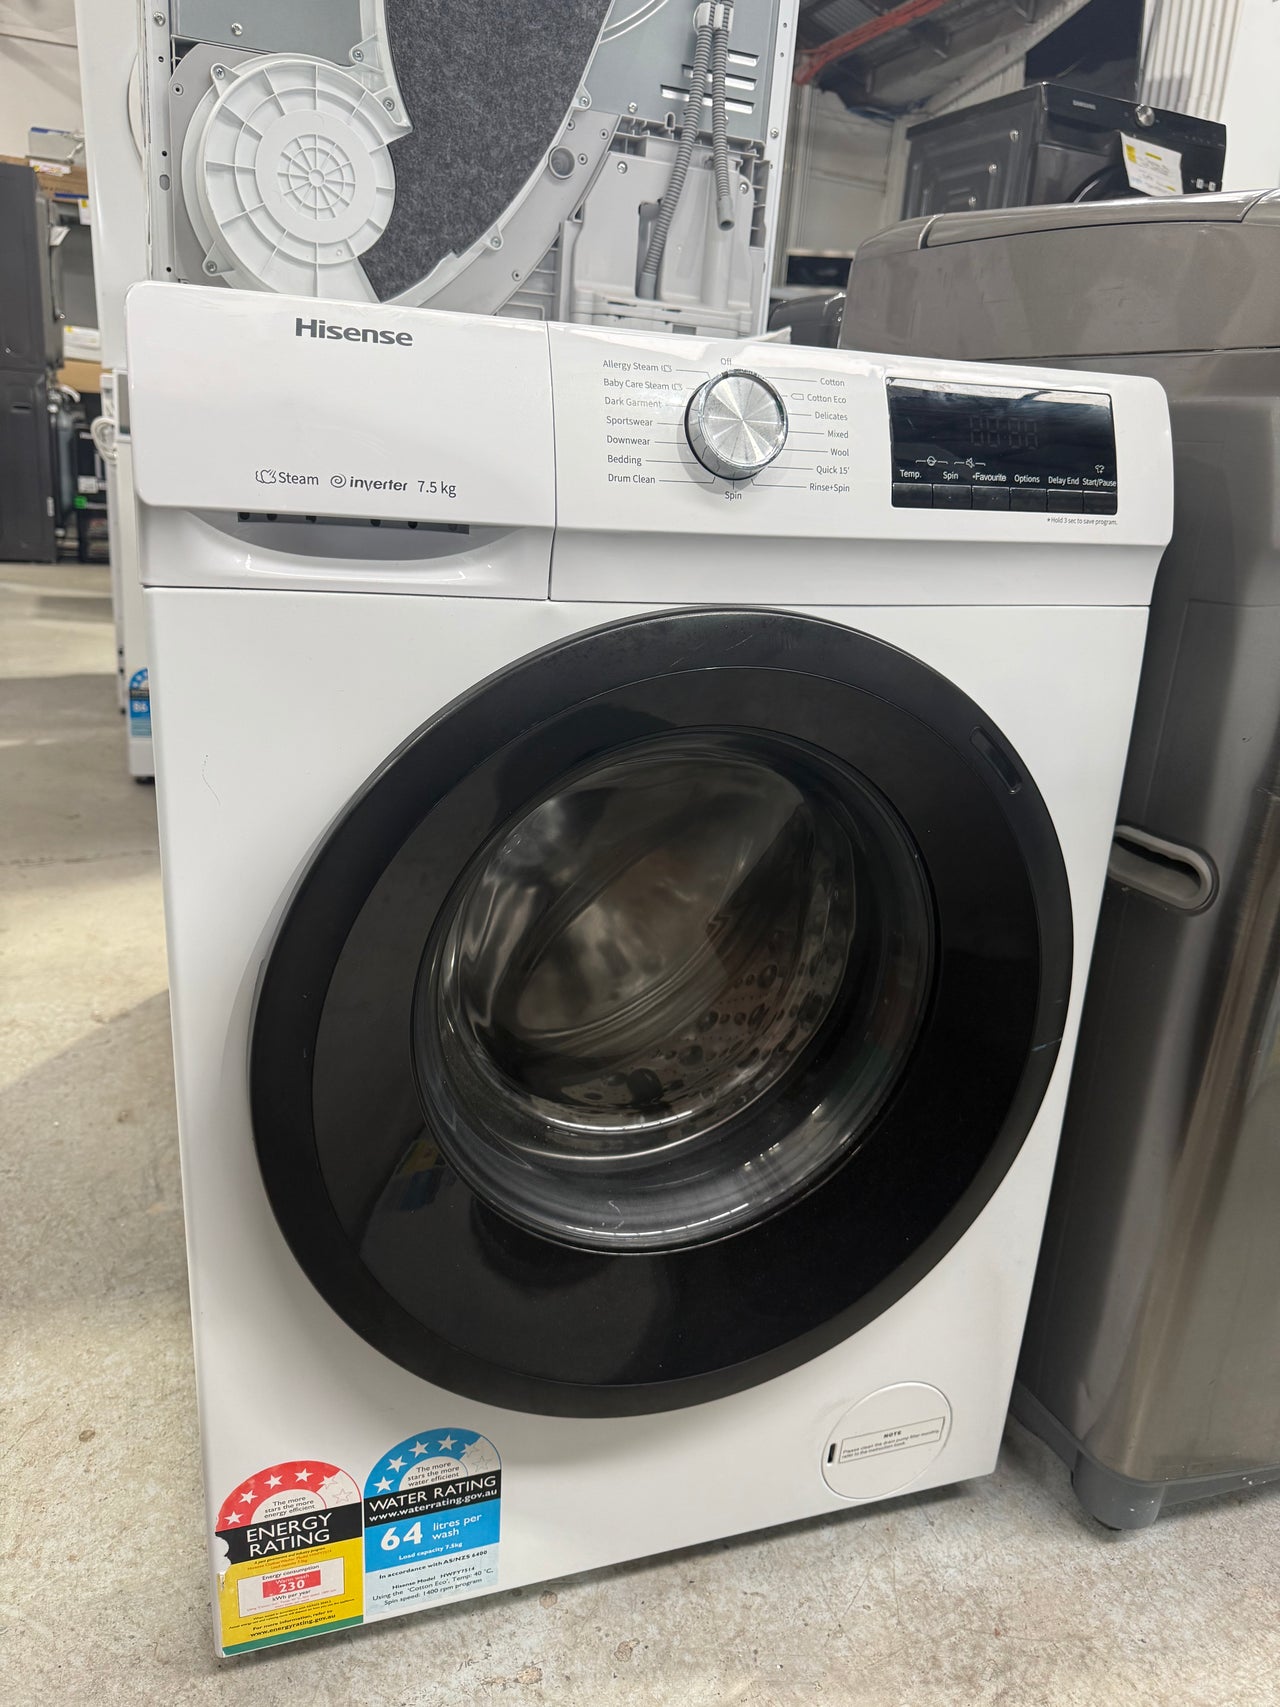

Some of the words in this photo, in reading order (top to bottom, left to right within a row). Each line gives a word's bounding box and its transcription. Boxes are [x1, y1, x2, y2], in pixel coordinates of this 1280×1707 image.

[295, 317, 413, 347] Hisense
[602, 359, 631, 371] Allergy
[634, 362, 659, 372] Steam
[720, 357, 732, 366] Off
[603, 378, 624, 390] Baby
[625, 380, 645, 389] Care
[645, 381, 670, 391] Steam
[820, 377, 845, 387] Cotton
[604, 396, 624, 406] Dark
[626, 398, 663, 408] Garment
[807, 393, 832, 403] Cotton
[834, 395, 847, 404] Eco
[606, 416, 653, 427] Sportswear
[814, 411, 848, 421] Delicates
[606, 435, 650, 446] Downwear
[827, 429, 849, 439] Mixed
[830, 447, 850, 457] Wool
[607, 454, 642, 467] Bedding
[816, 465, 838, 476] Quick
[900, 469, 922, 480] Temp.
[943, 471, 959, 481] Spin
[278, 471, 319, 486] Steam
[350, 476, 408, 492] inverter
[608, 473, 631, 483] Drum
[633, 474, 656, 484] Clean
[1014, 474, 1040, 484] Options
[1048, 476, 1066, 486] Delay
[1067, 477, 1080, 486] End
[1082, 478, 1117, 488] Start/Pause
[417, 480, 438, 494] 7.5
[441, 481, 457, 498] kg
[809, 482, 851, 493] Rinse+Spin
[724, 490, 742, 502] Spin
[883, 1430, 902, 1439] NOTE
[407, 1473, 426, 1482] stars
[427, 1470, 439, 1478] the
[440, 1465, 460, 1475] more
[416, 1465, 431, 1473] The
[431, 1461, 452, 1471] more
[408, 1478, 429, 1488] water
[431, 1471, 459, 1483] efficient
[369, 1490, 428, 1512] WATER
[434, 1475, 497, 1499] RATING
[264, 1506, 281, 1514] stars
[295, 1499, 314, 1508] more
[272, 1499, 286, 1507] The
[287, 1496, 306, 1504] more
[368, 1488, 498, 1522] www.waterrating.gov.au
[264, 1509, 288, 1519] energy
[289, 1504, 316, 1514] efficient
[246, 1512, 332, 1543] ENERGY
[433, 1519, 460, 1531] litres
[463, 1513, 482, 1526] per
[380, 1521, 423, 1551] 64
[432, 1527, 460, 1541] wash
[249, 1528, 330, 1557] RATING
[398, 1551, 416, 1561] Load
[416, 1545, 444, 1557] capacity
[387, 1564, 426, 1578] accordance
[427, 1561, 443, 1569] with
[443, 1553, 471, 1565] AS/NZS
[471, 1549, 488, 1558] 6400
[262, 1570, 282, 1581] Energy
[283, 1564, 320, 1577] consumption
[278, 1579, 305, 1594] 230
[372, 1592, 391, 1602] Using
[392, 1589, 404, 1597] the
[473, 1569, 482, 1577] 40
[392, 1580, 416, 1590] Hisense
[417, 1575, 436, 1584] Model
[272, 1594, 287, 1602] kWh
[288, 1592, 298, 1600] per
[299, 1589, 311, 1597] year
[384, 1597, 399, 1607] Spin
[423, 1587, 439, 1597] 1400
[439, 1584, 454, 1594] rpm
[454, 1578, 483, 1590] program
[250, 1613, 336, 1638] www.energyrating.gov.au
[252, 1623, 262, 1631] For
[263, 1620, 278, 1629] more
[279, 1613, 312, 1625] information,
[312, 1610, 325, 1619] refer
